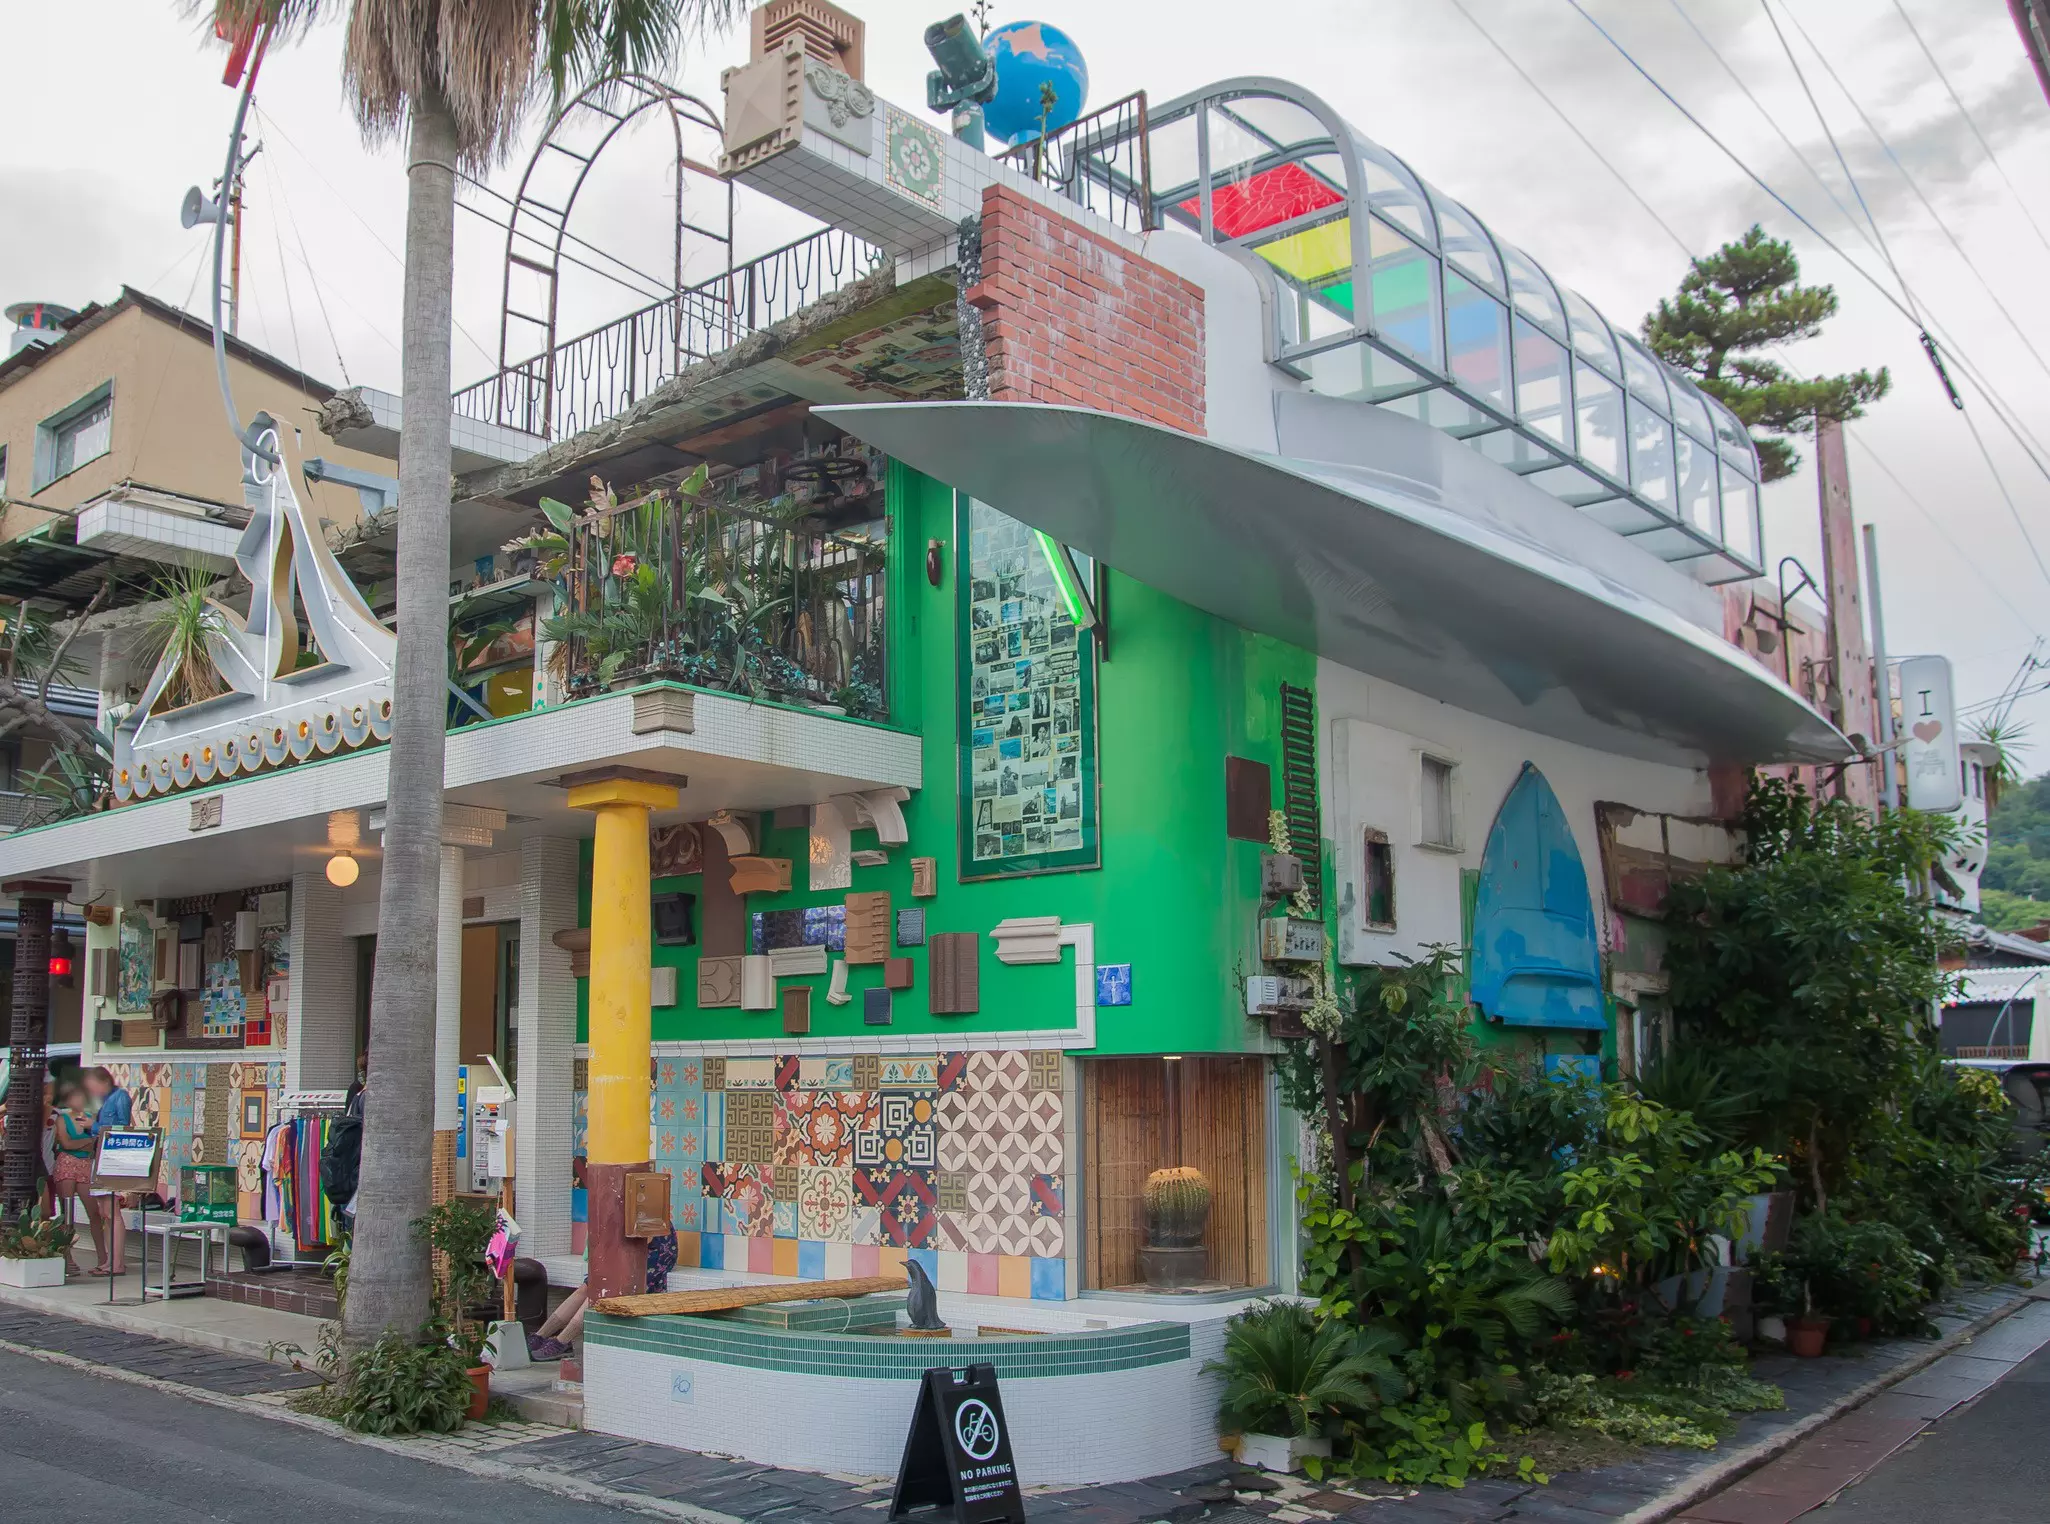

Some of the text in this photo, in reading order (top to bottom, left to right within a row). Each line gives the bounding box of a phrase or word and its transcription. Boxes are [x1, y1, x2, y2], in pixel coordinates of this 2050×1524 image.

[1918, 690, 1933, 716] I
[960, 1463, 1011, 1480] NO PARKING
